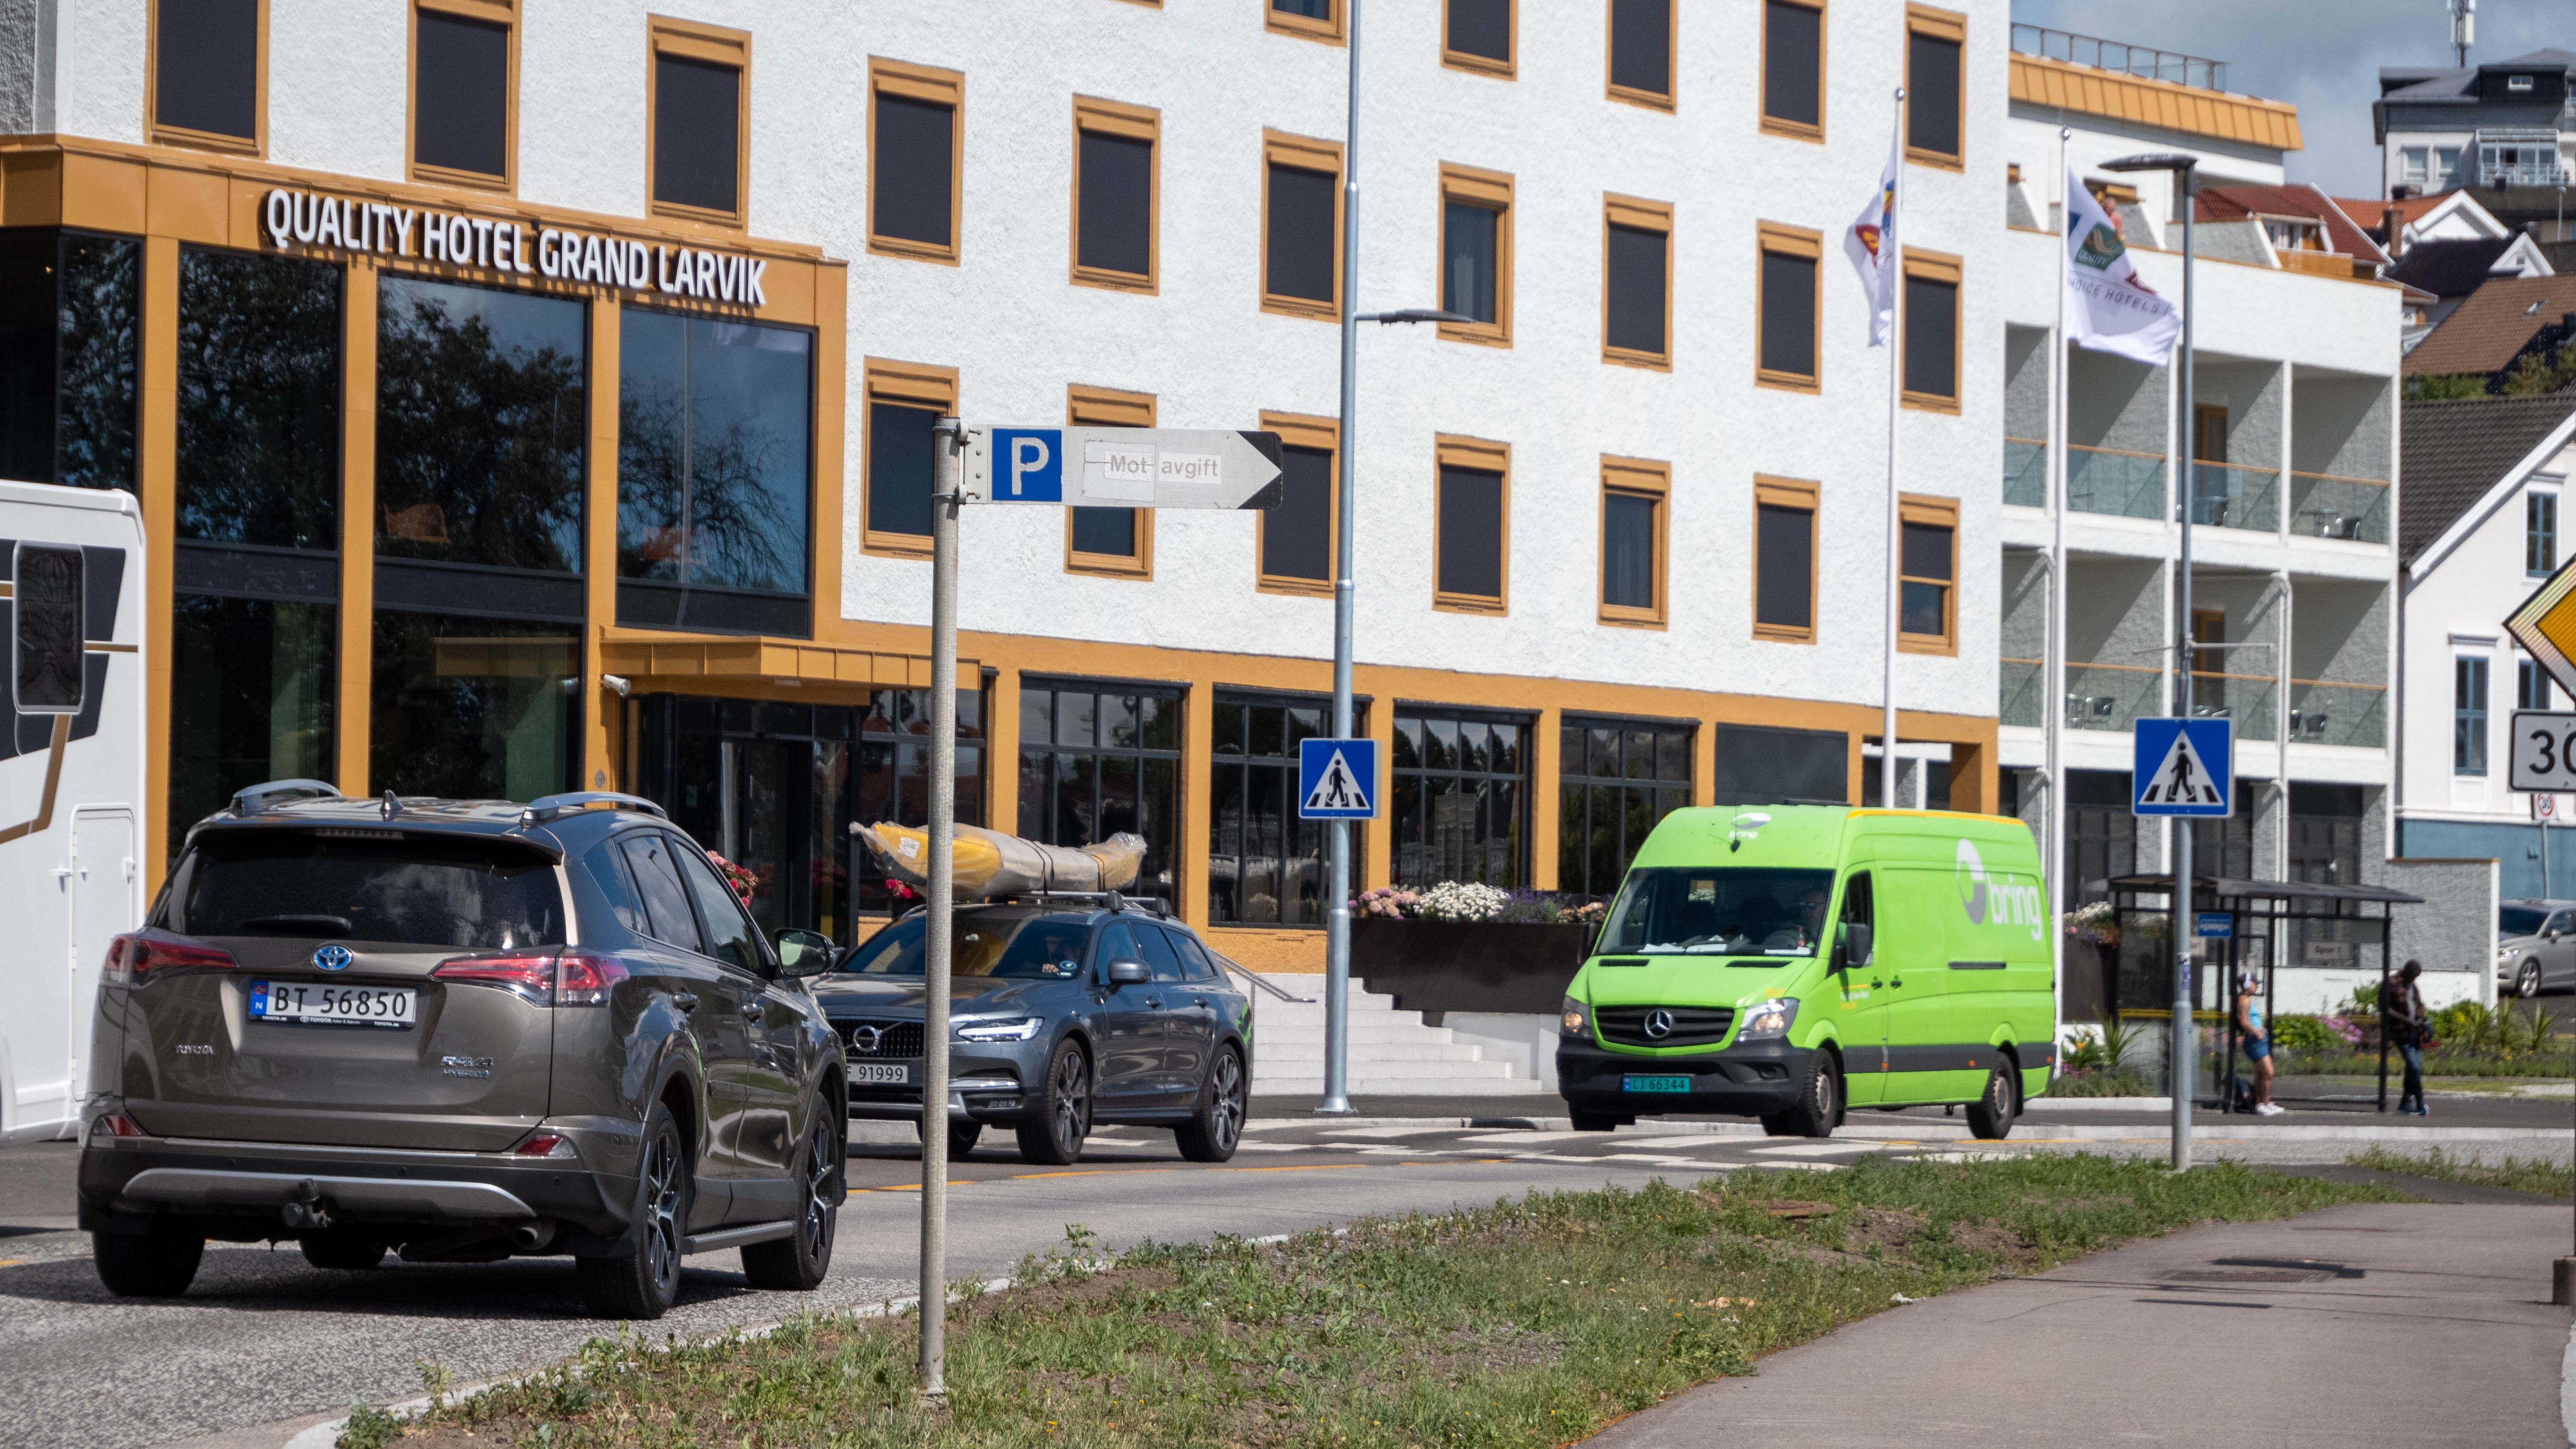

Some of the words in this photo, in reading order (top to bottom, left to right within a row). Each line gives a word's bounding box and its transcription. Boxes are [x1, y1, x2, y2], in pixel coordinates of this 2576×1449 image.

[267, 188, 413, 256] QUALITY
[423, 211, 530, 273] HOTEL
[538, 228, 648, 290] GRAND
[658, 245, 767, 305] LARVIK
[2069, 277, 2102, 297] HOICE
[2104, 287, 2161, 314] HOTELS
[1011, 437, 1049, 495] P
[1110, 454, 1147, 474] Mot
[1161, 458, 1217, 479] avgift
[1986, 872, 2043, 941] bring
[274, 986, 308, 1012] BT
[320, 988, 406, 1017] 56850
[859, 1065, 903, 1081] 91999
[1649, 1078, 1685, 1090] 66344
